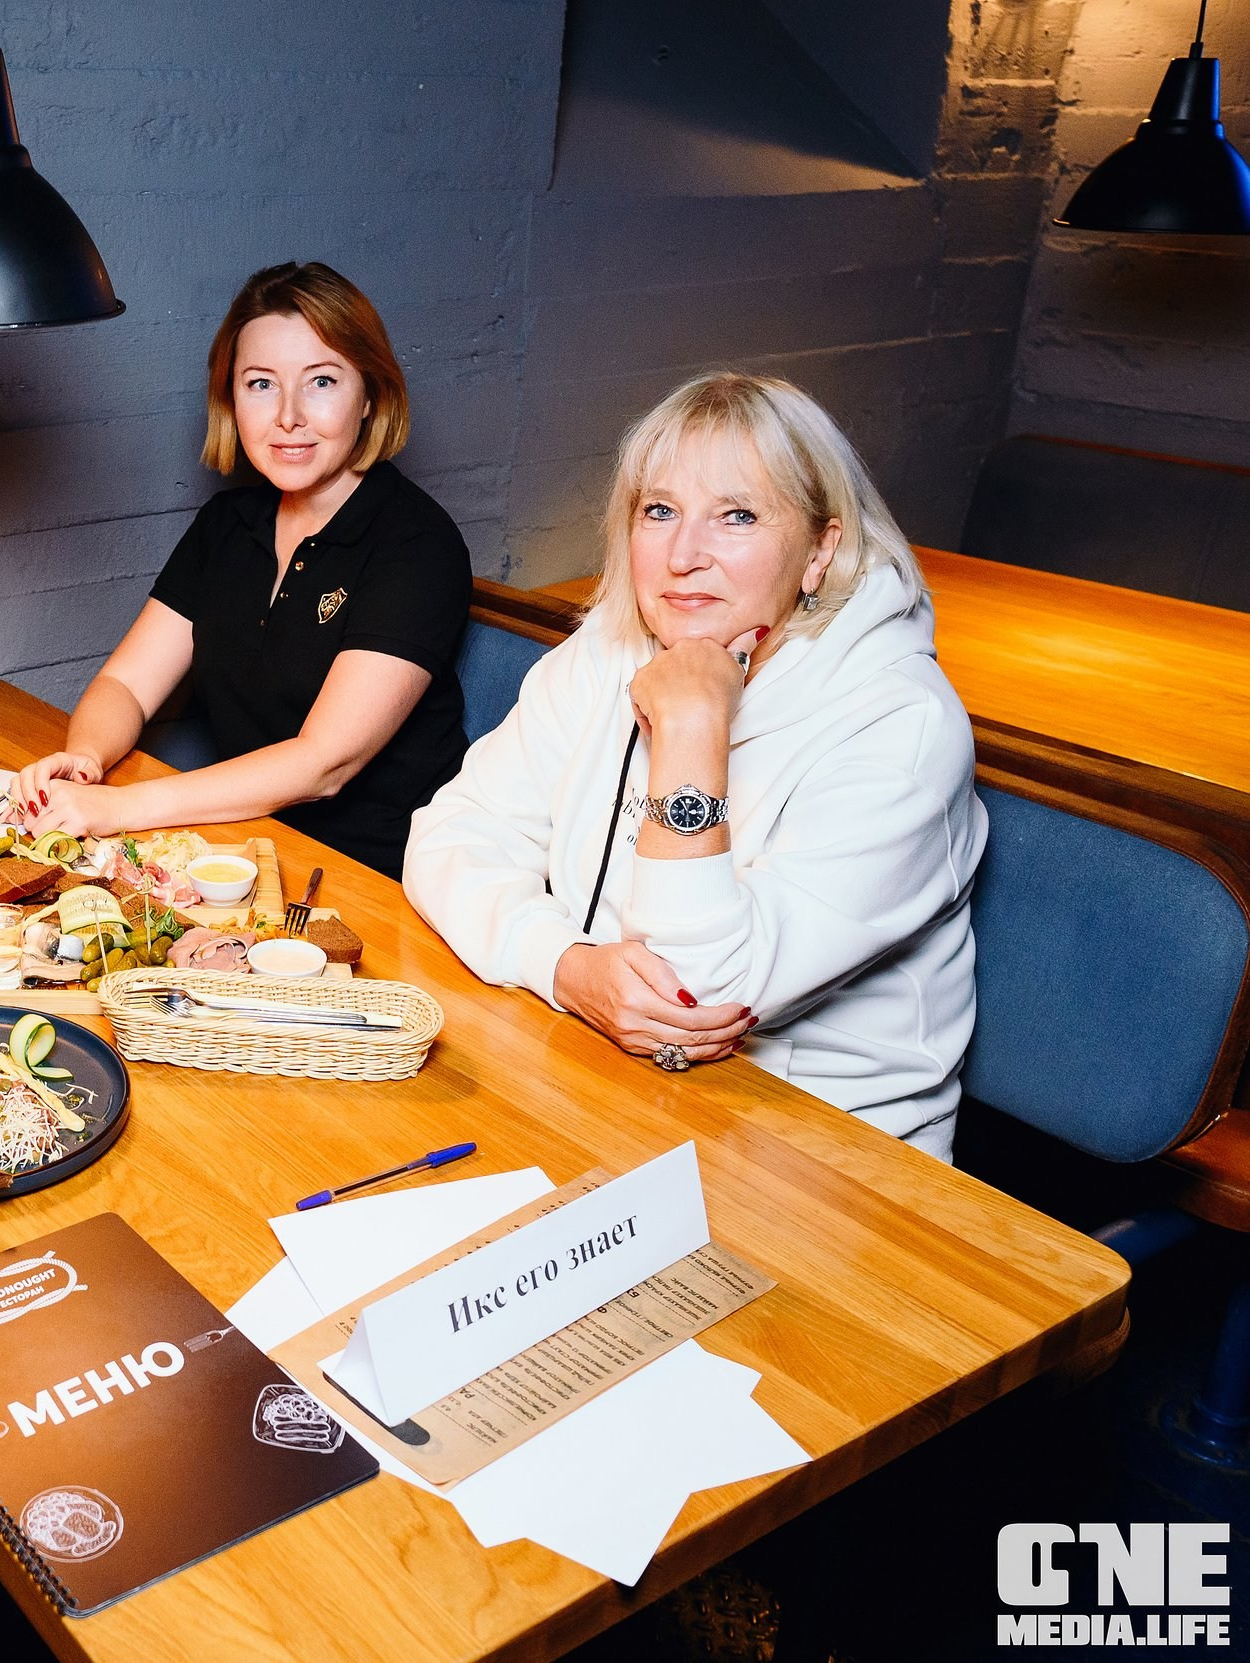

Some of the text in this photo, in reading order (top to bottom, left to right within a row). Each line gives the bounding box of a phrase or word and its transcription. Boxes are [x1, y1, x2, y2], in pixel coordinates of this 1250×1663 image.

[448, 1215, 637, 1333] Икс его знает
[7, 1341, 185, 1438] МЕНЮ
